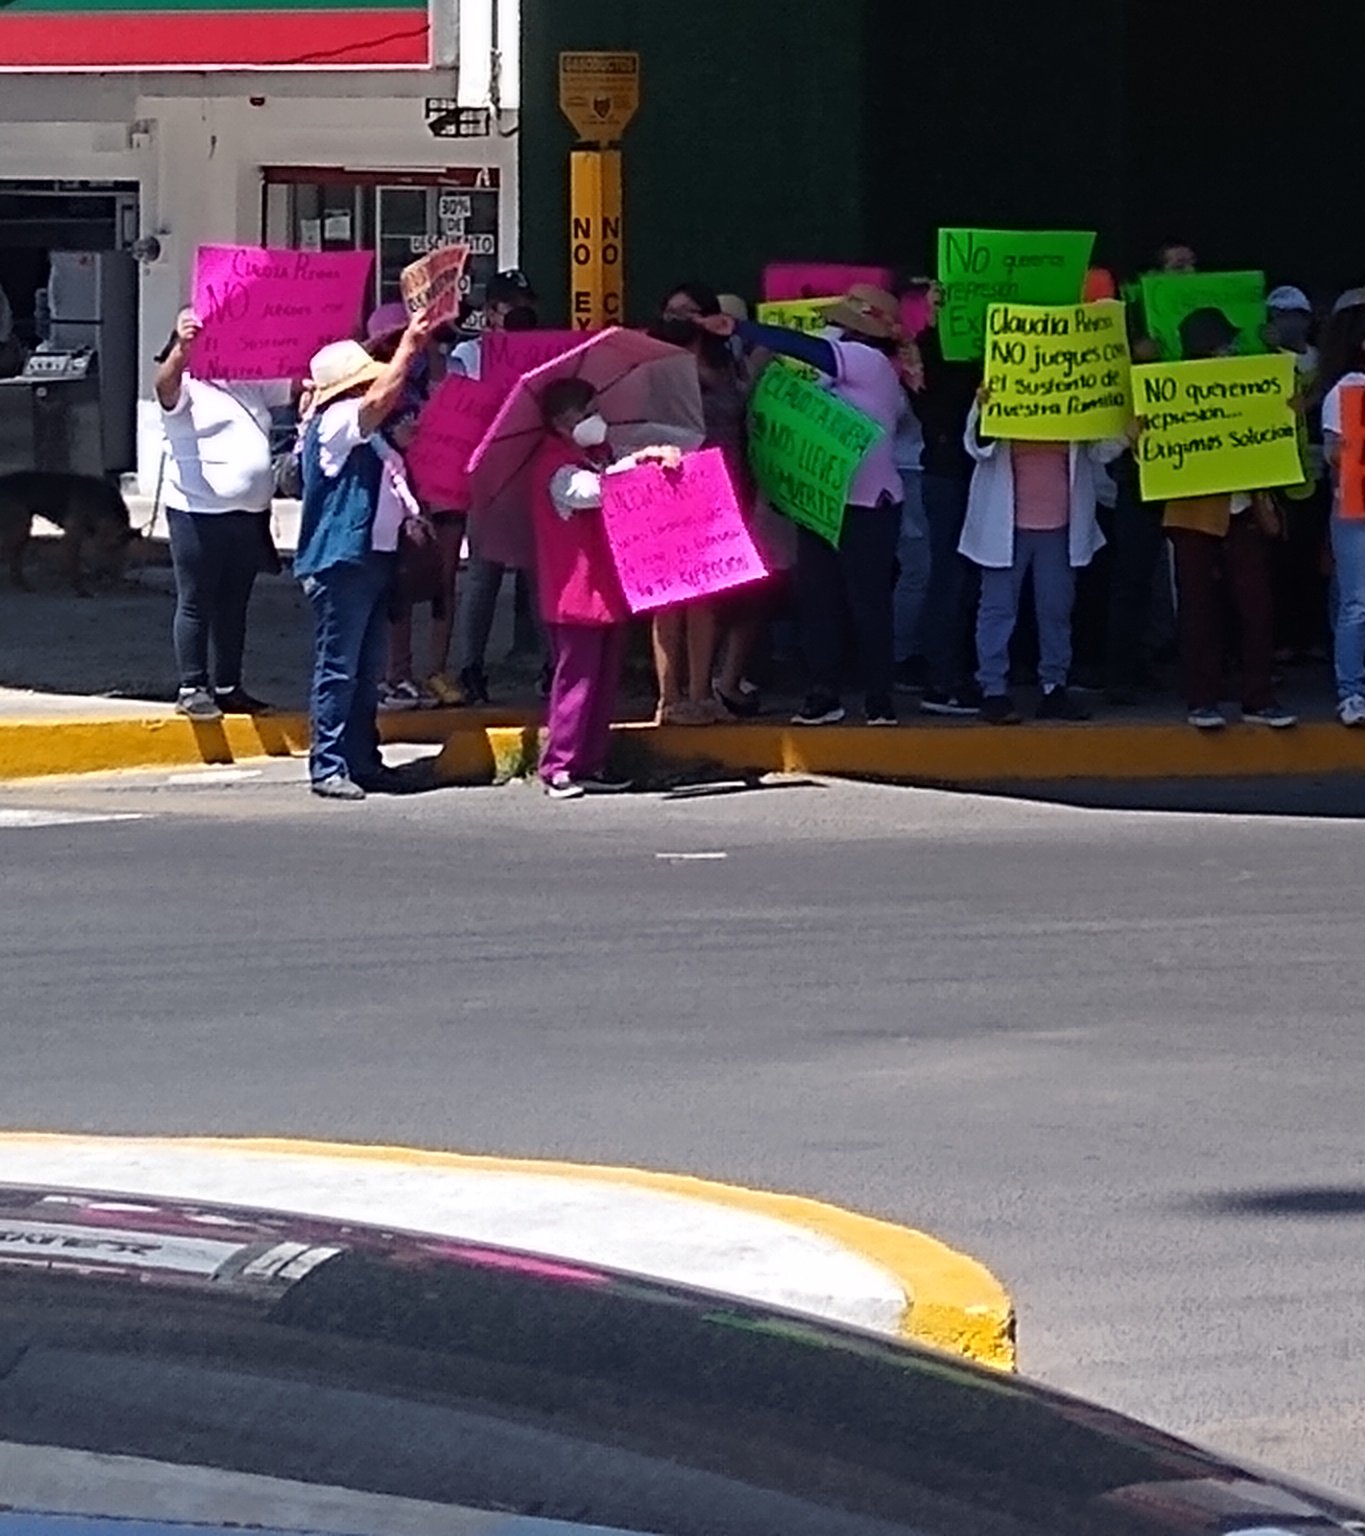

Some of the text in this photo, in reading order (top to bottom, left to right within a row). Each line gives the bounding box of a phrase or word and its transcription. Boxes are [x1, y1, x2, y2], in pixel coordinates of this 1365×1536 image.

[442, 199, 468, 215] 30%
[991, 342, 1025, 366] NO
[1143, 376, 1178, 404] NO
